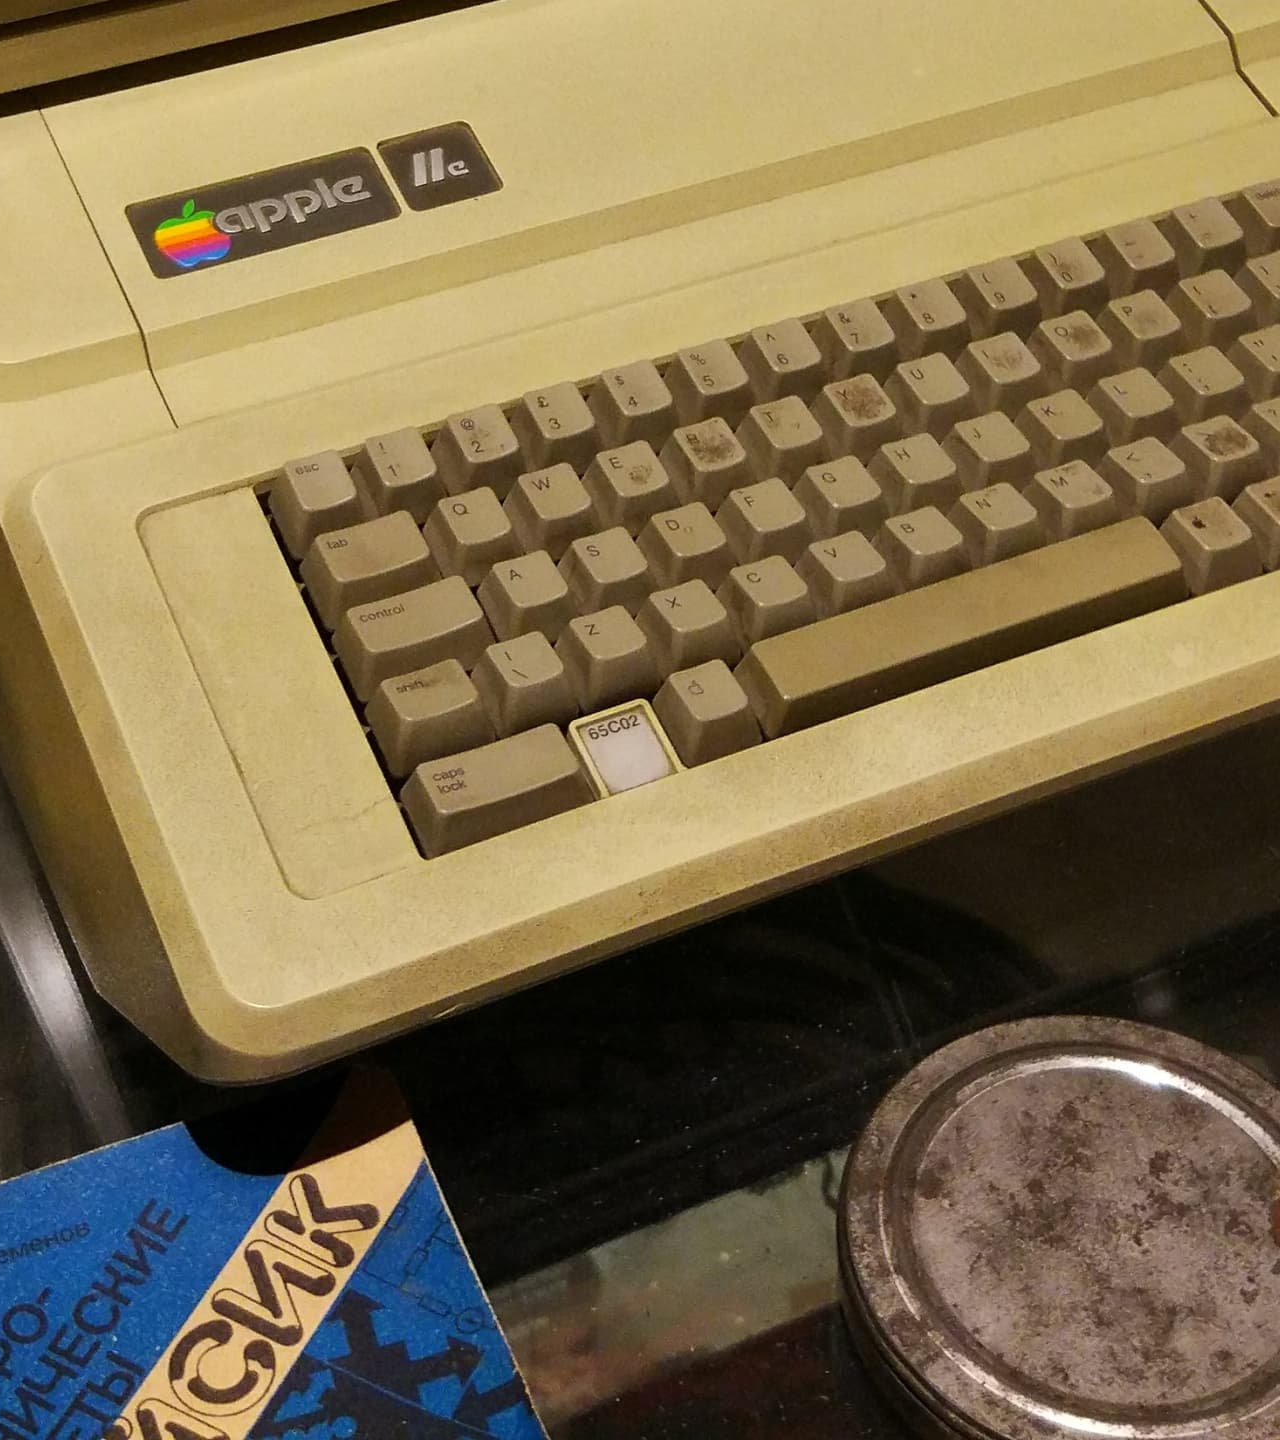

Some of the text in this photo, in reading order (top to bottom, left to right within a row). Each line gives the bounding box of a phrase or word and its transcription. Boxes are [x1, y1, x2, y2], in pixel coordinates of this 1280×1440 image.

[214, 174, 373, 235] apple
[326, 534, 348, 550] tab
[357, 602, 407, 624] control
[587, 714, 641, 741] 65C02
[432, 766, 466, 784] caps
[437, 778, 468, 796] lock
